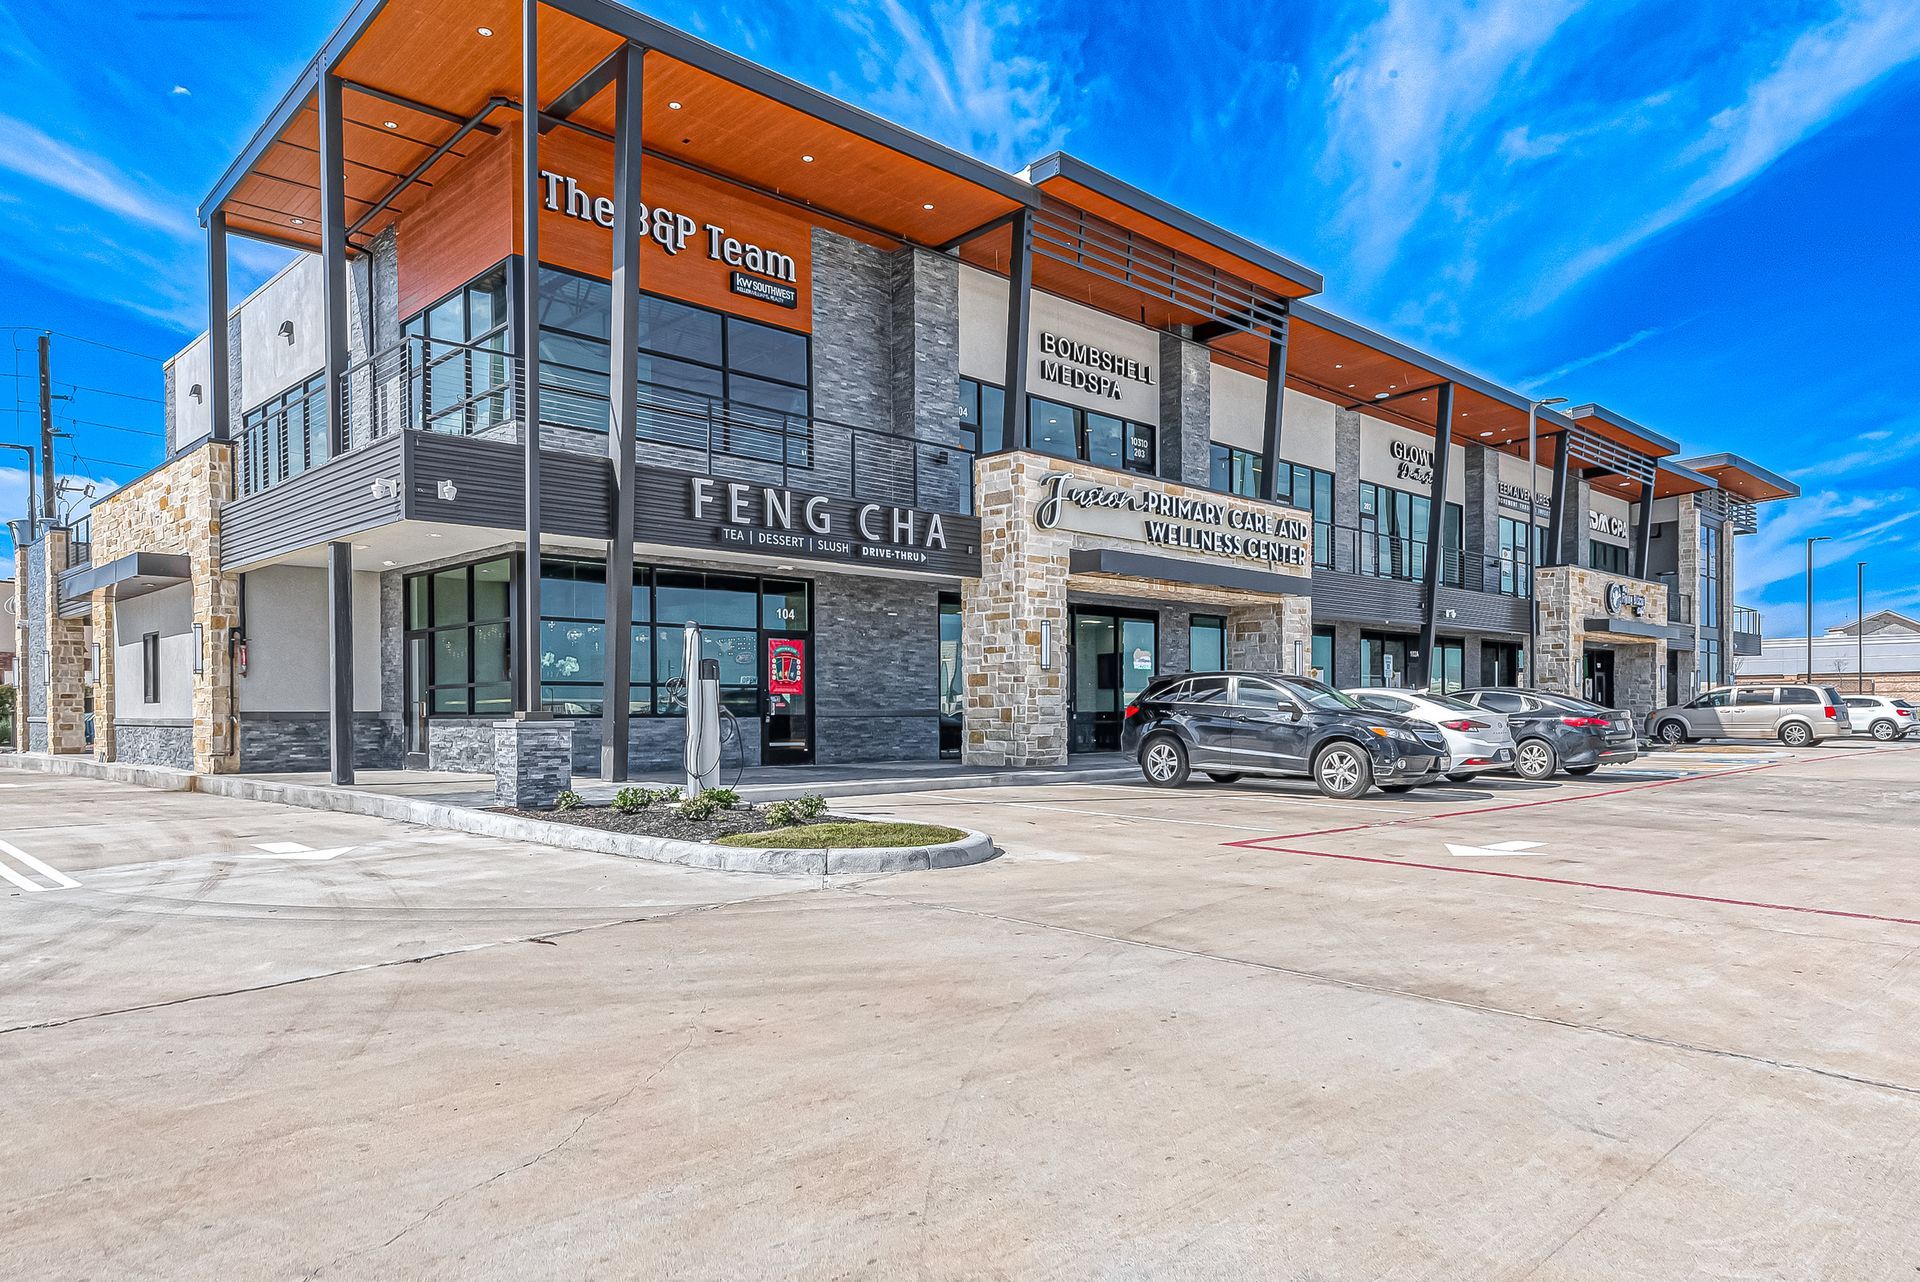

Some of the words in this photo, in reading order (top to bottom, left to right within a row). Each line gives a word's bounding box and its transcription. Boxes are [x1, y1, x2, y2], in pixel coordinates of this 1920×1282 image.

[541, 170, 614, 228] The
[703, 223, 797, 283] Team
[752, 281, 795, 301] SOUTHWEST
[1042, 332, 1157, 385] BOMBSHELL
[1042, 359, 1123, 401] MEDSPA
[958, 406, 968, 417] 04
[1130, 436, 1149, 448] 10310
[1133, 448, 1146, 458] 203
[1391, 441, 1430, 466] GLOW
[1498, 481, 1513, 496] EEM
[691, 477, 832, 535] FENG
[858, 503, 948, 549] CHA
[1147, 491, 1227, 525] PRIMARY
[1230, 509, 1273, 533] CARE
[1276, 519, 1309, 541] AND
[1611, 517, 1628, 538] CPA
[723, 528, 745, 542] TEA
[758, 532, 804, 548] DESSERT
[817, 539, 849, 554] SLUSH
[862, 546, 919, 562] DRIVE-THRU
[1147, 521, 1242, 555] WELLNESS
[1244, 537, 1307, 565] CENTER
[776, 608, 795, 620] 104
